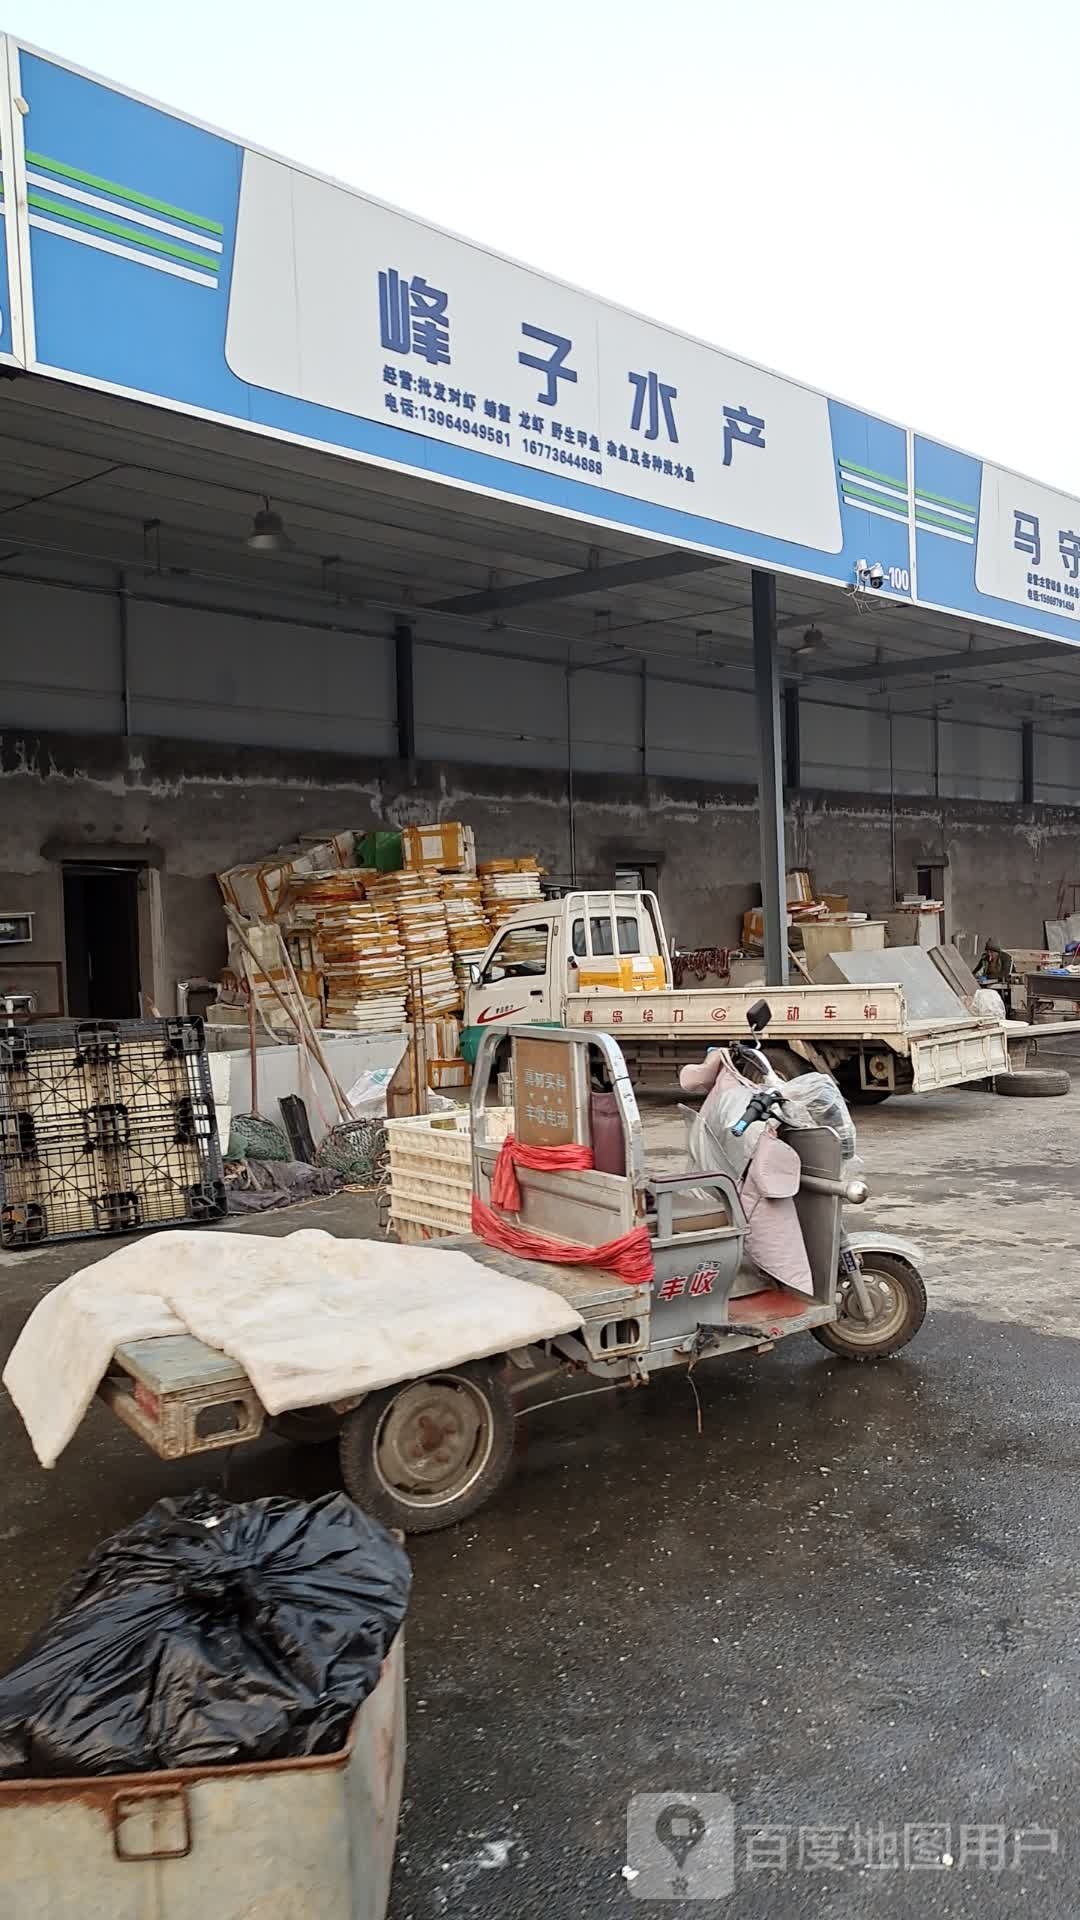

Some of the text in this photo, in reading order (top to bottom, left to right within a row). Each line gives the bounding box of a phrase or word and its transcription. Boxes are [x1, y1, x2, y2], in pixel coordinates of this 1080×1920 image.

[378, 268, 766, 466] 峰子水产
[522, 438, 603, 475] 16773644888
[583, 1004, 878, 1024] 青岛给力 动车辆
[657, 1269, 720, 1301] 丰收
